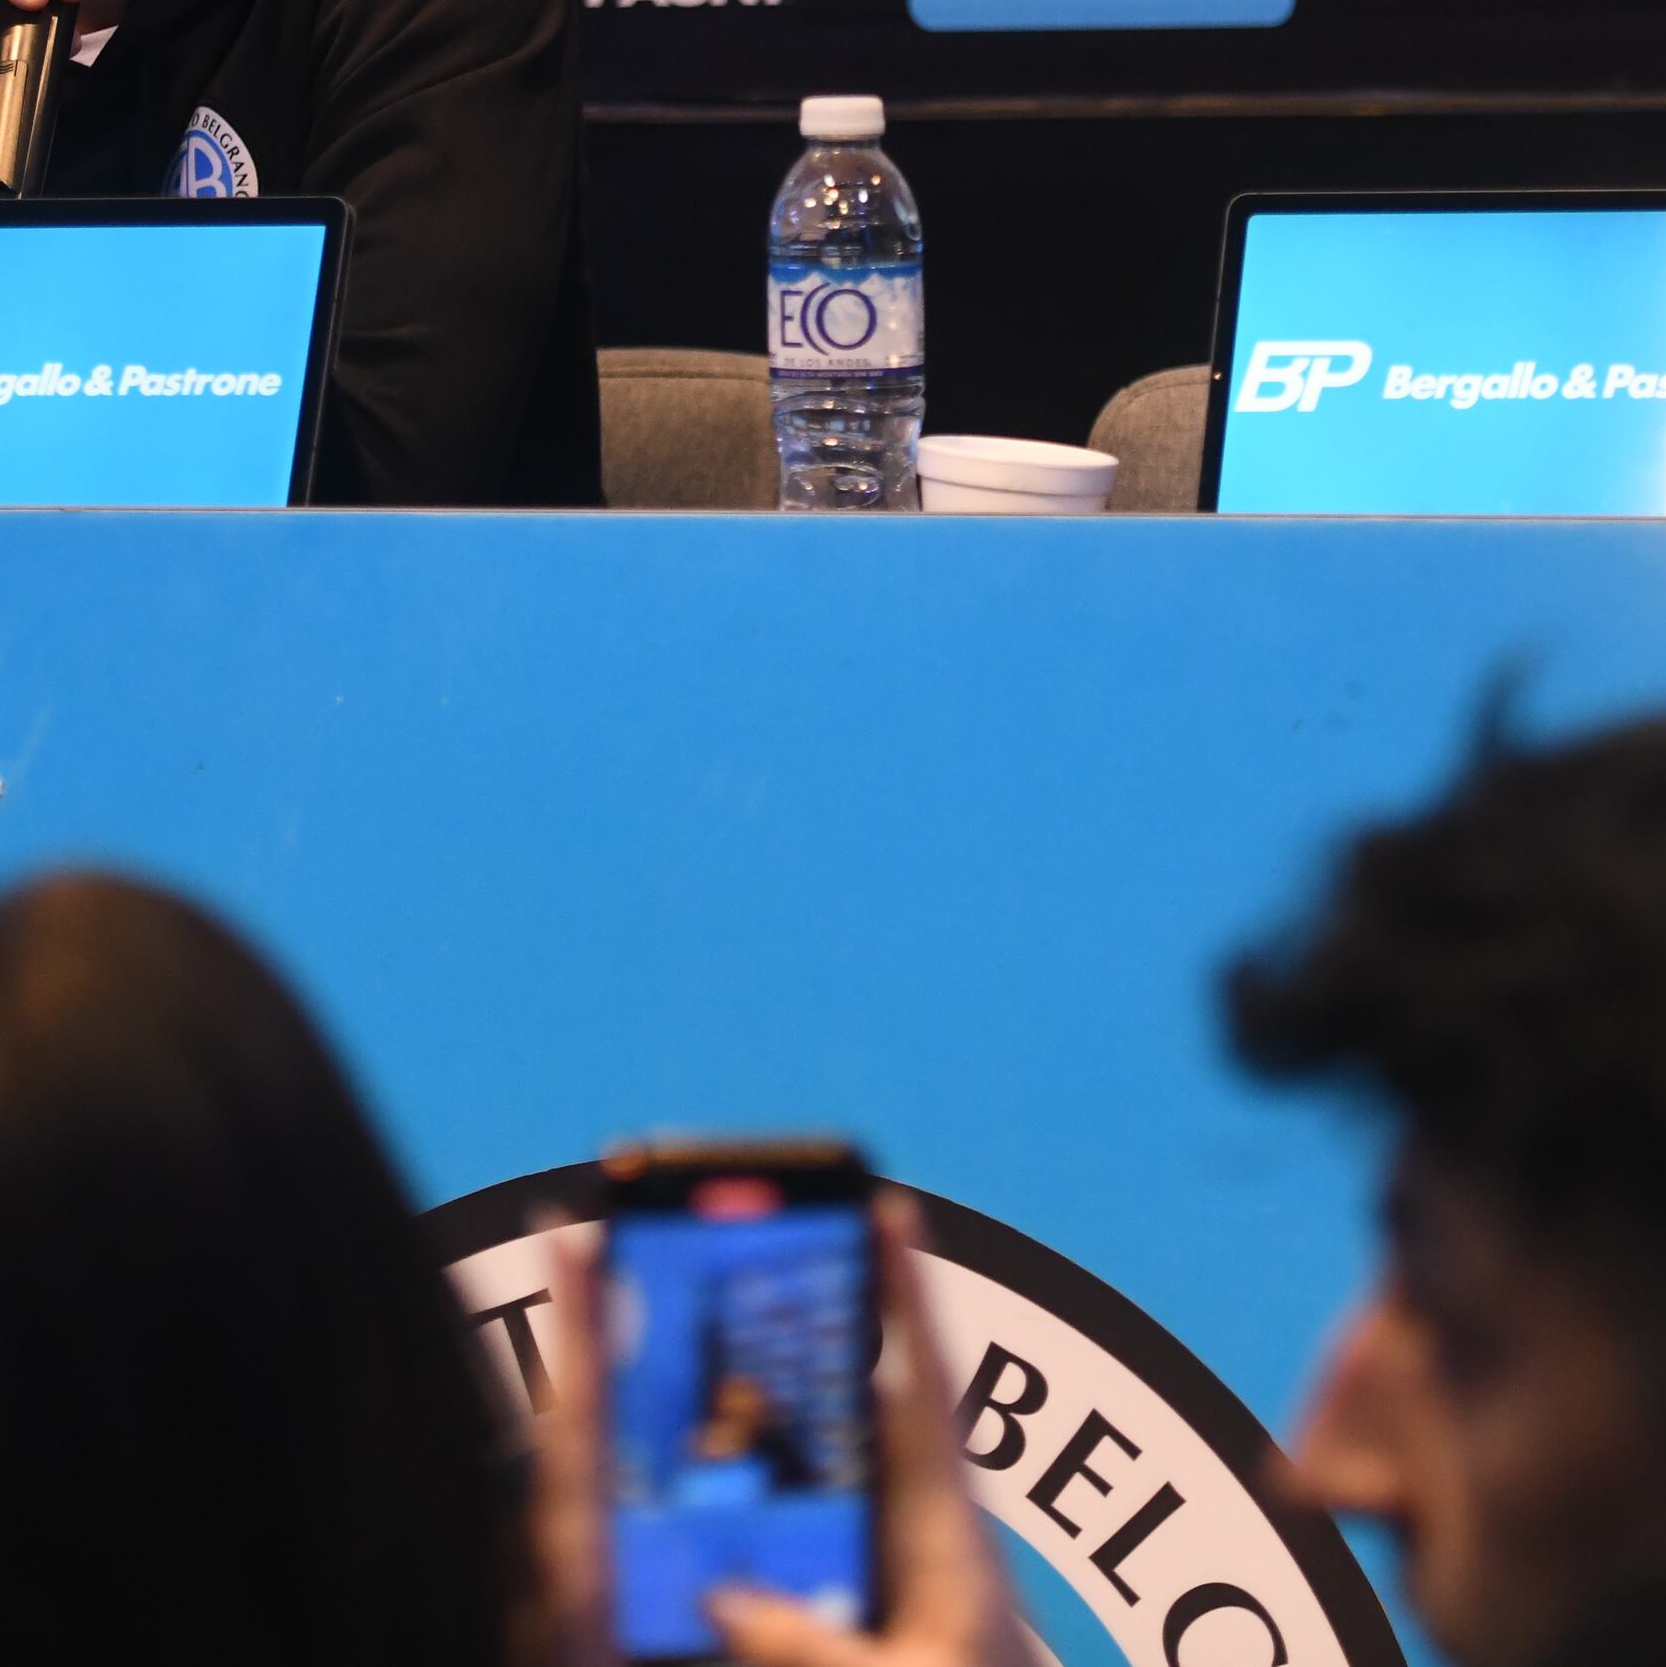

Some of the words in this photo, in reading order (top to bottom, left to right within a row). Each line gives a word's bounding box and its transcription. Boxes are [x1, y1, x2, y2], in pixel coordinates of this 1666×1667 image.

[84, 365, 113, 397] &
[118, 363, 282, 398] Pastrone
[1383, 361, 1557, 410] Bergallo
[1562, 364, 1597, 399] &
